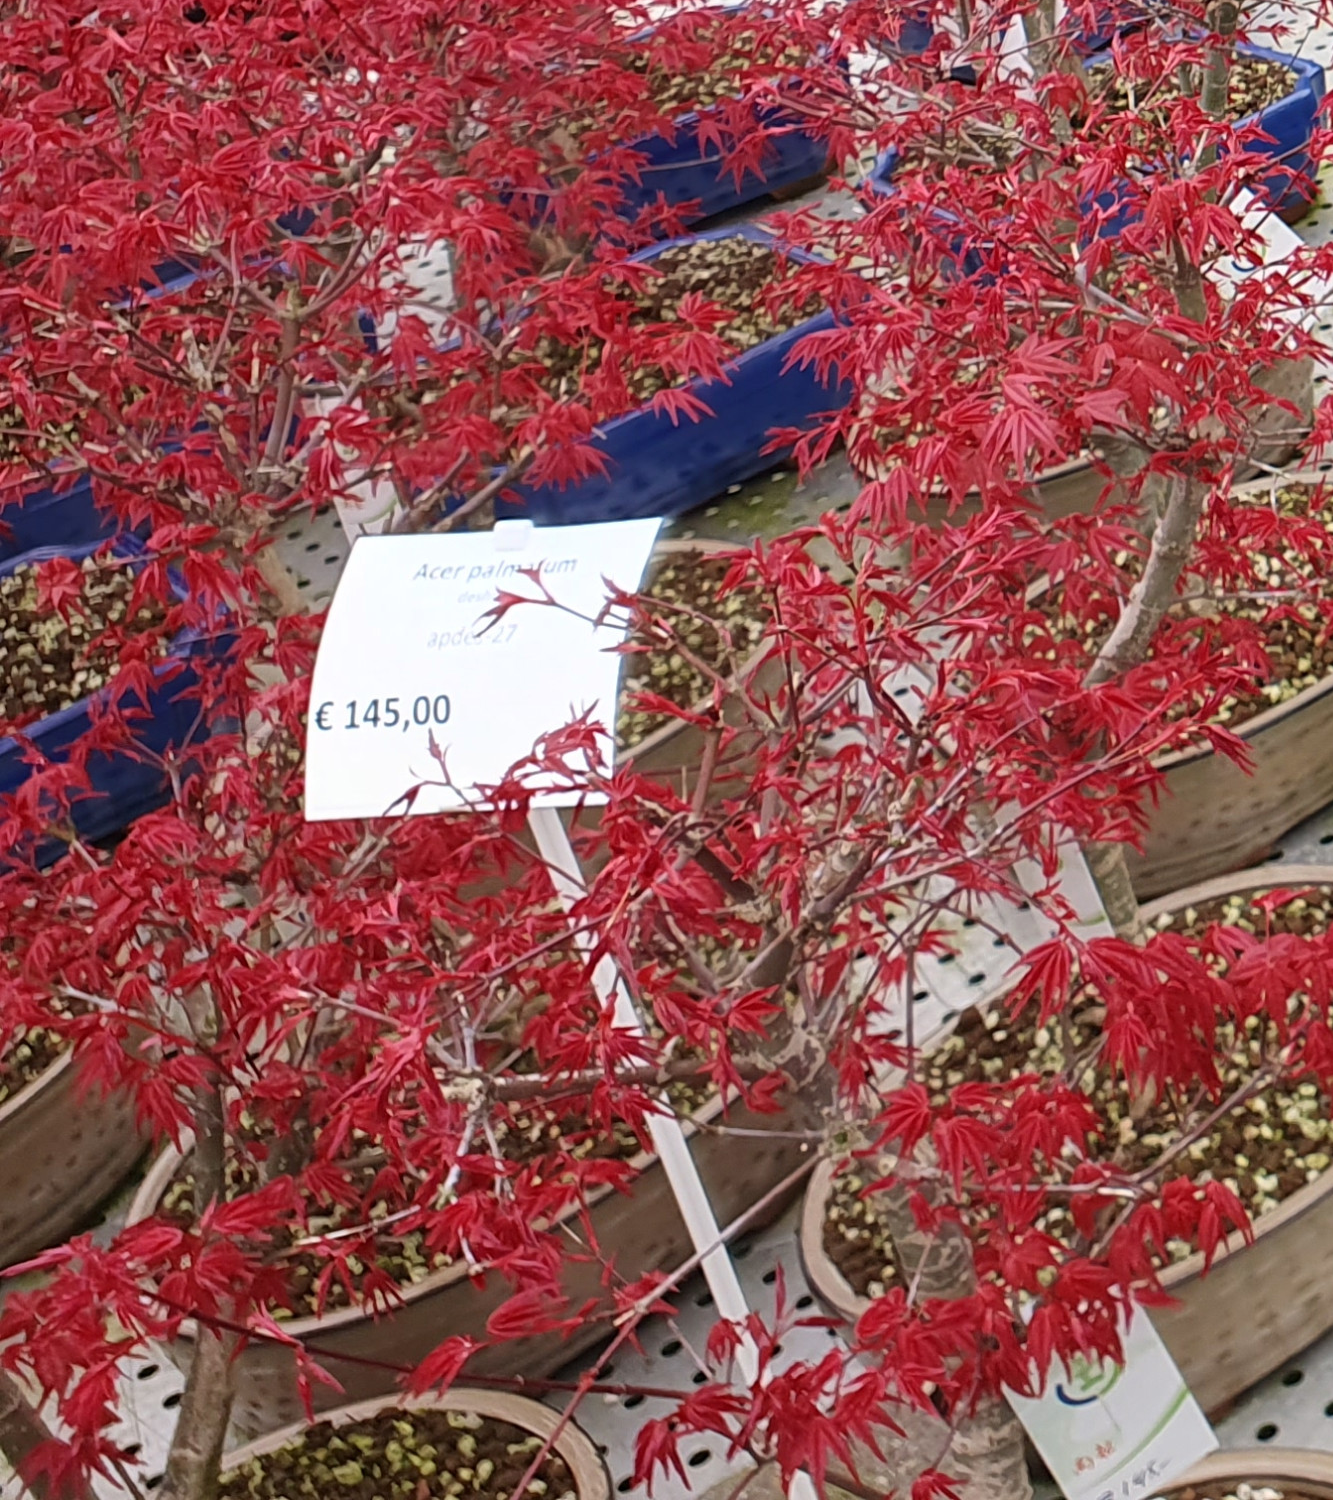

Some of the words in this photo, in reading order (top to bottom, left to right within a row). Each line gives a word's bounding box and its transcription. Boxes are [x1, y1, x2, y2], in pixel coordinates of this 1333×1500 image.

[413, 562, 465, 581] Acer
[466, 558, 578, 584] palmum
[315, 701, 334, 731] €
[344, 694, 451, 733] 145,00
